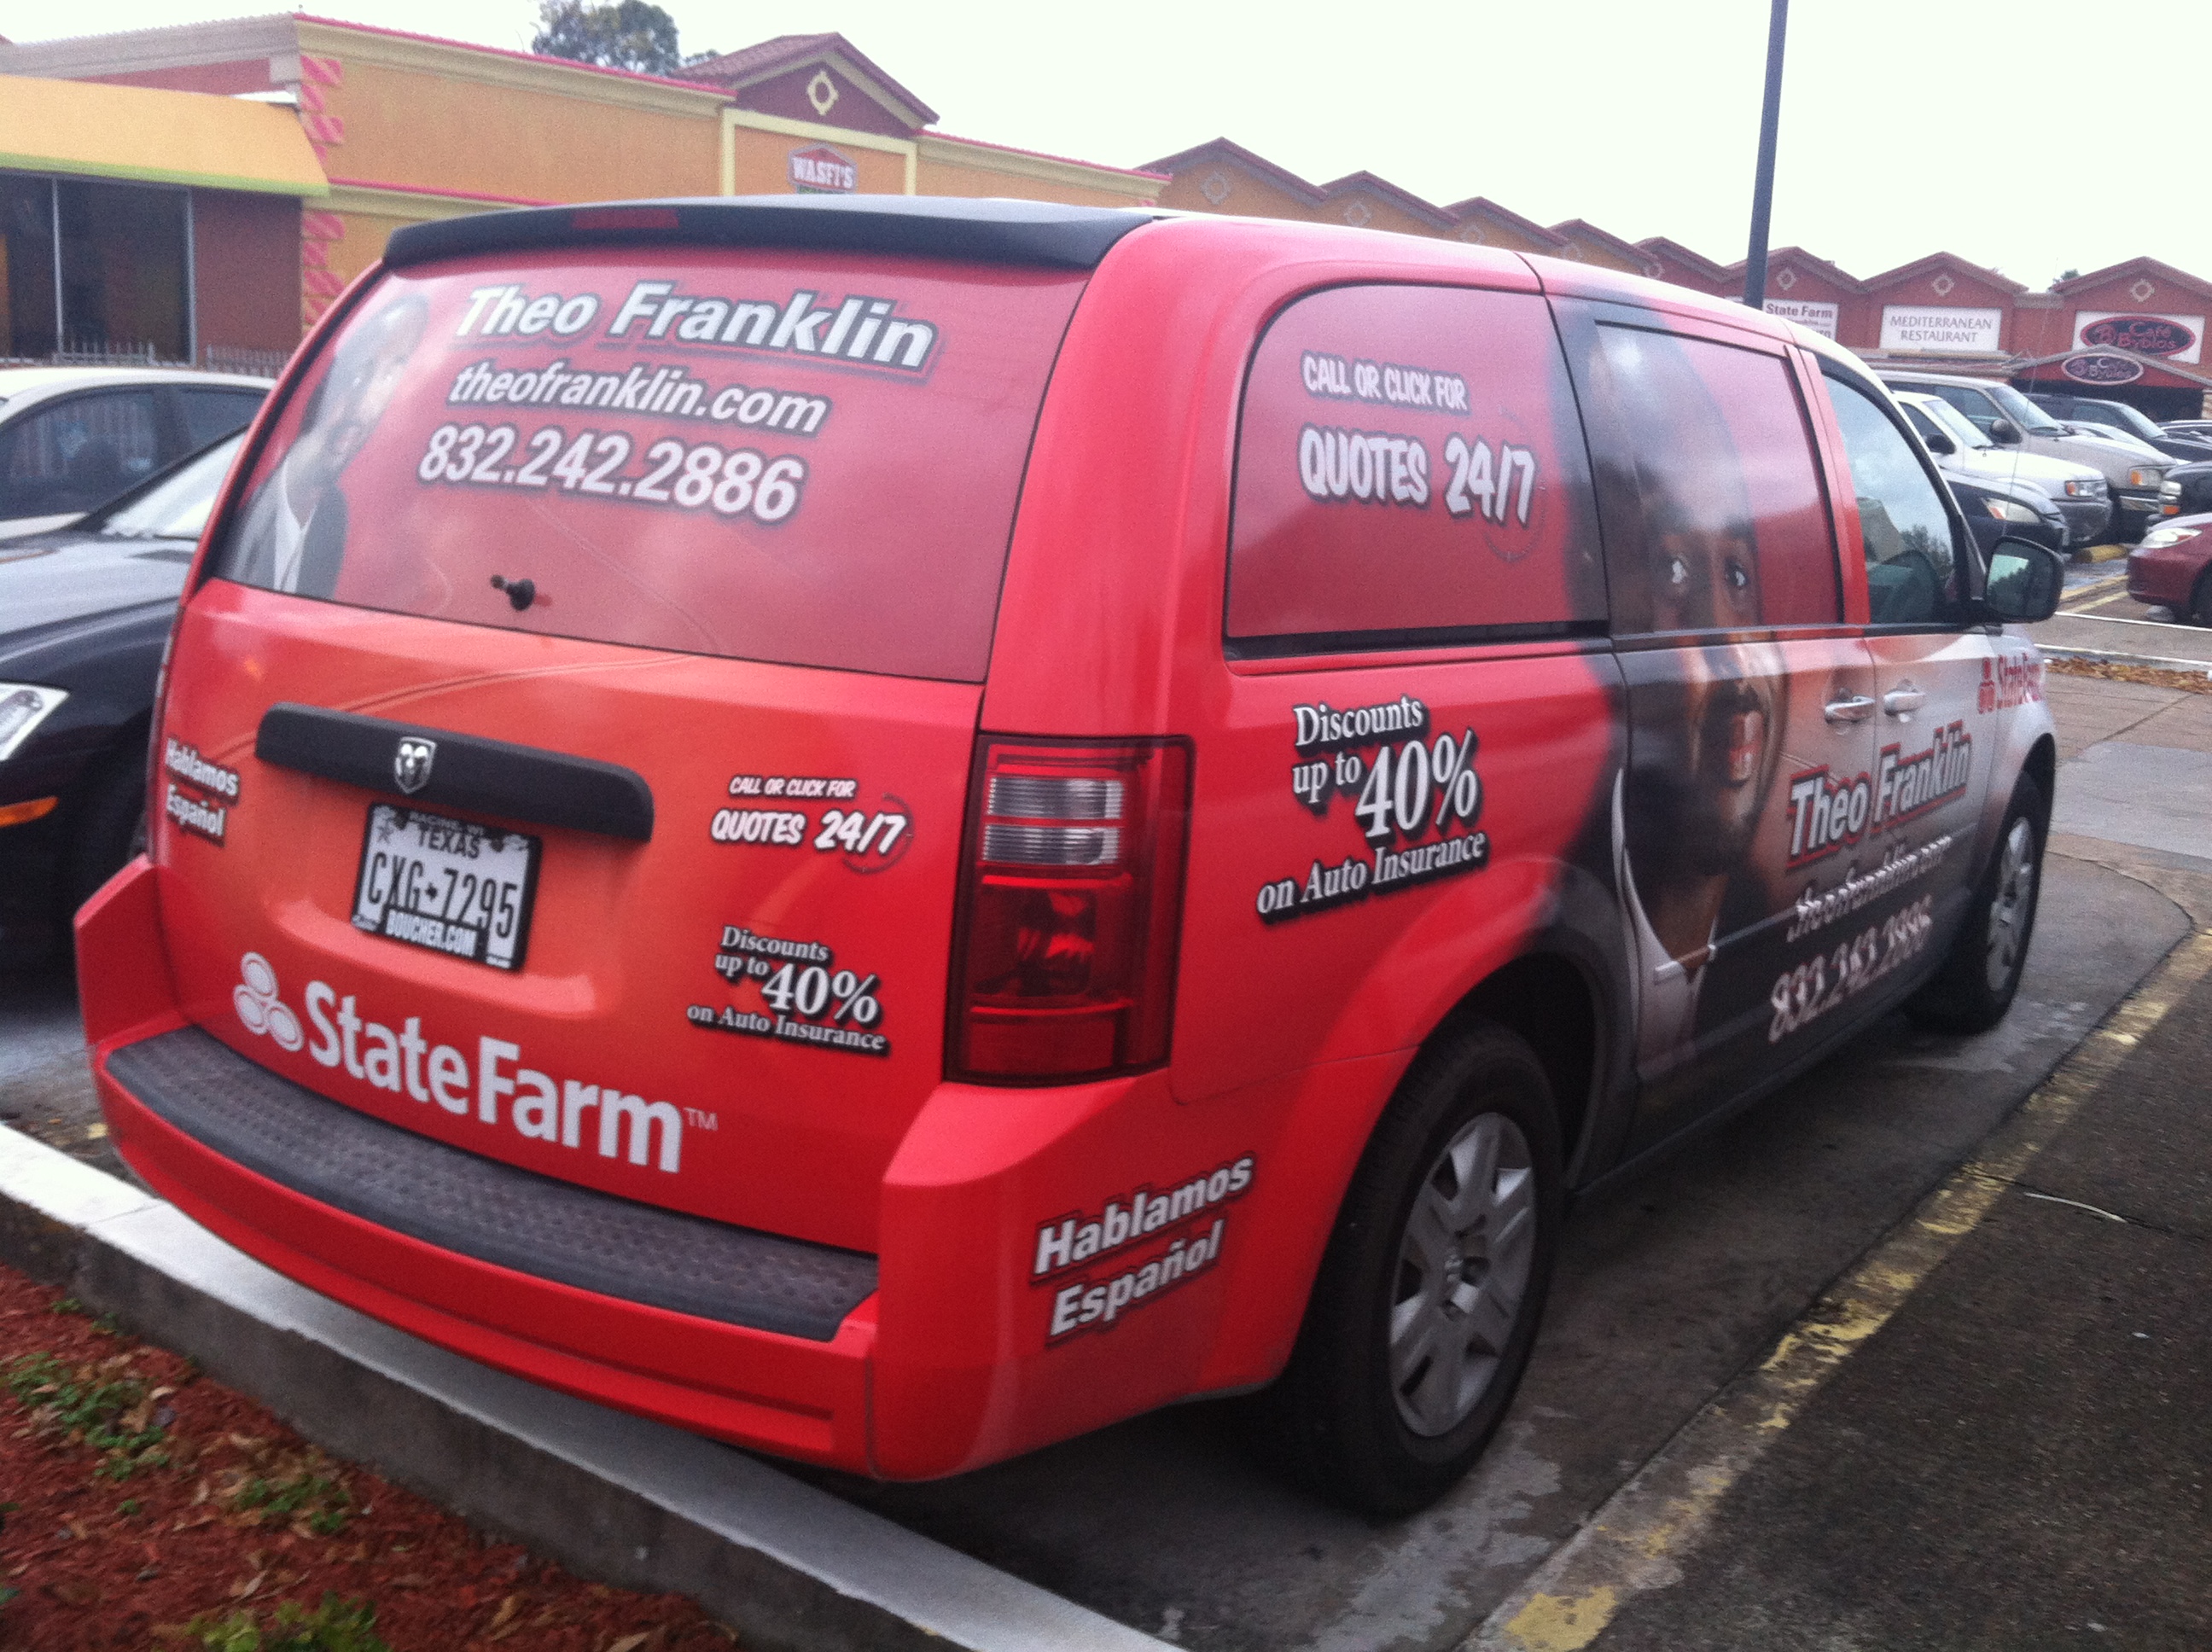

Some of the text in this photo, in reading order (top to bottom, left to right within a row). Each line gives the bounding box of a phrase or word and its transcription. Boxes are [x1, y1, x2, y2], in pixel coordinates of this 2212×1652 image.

[455, 281, 934, 367] Theo Franklin
[1766, 303, 1833, 318] State Farm
[1889, 316, 1993, 329] MEDITERRANEAN
[1900, 329, 1978, 342] RESTAURANT
[448, 360, 827, 433] theofranklin.com
[1303, 355, 1468, 410] CALL OR CLICK FOR
[419, 425, 804, 522] 832.242.2886
[1299, 428, 1535, 525] QUOTES 24/7
[1294, 695, 1423, 747] Discounts
[165, 737, 238, 796] Hablamos
[729, 776, 857, 799] CALL OR CLICK FOR
[1293, 729, 1478, 838] up to 40%
[1790, 730, 1970, 857] Theo Franklin
[418, 823, 480, 859] TEXAS
[711, 809, 907, 854] QUOTES 24/7
[1257, 833, 1487, 914] on Auto Insurance
[721, 925, 830, 962] Discounts
[715, 953, 879, 1024] up to 40%
[686, 1005, 887, 1050] on Auto Insurance
[304, 979, 684, 1174] StateFarm
[1034, 1157, 1254, 1276] Hablamos
[1050, 1218, 1225, 1336] Español
